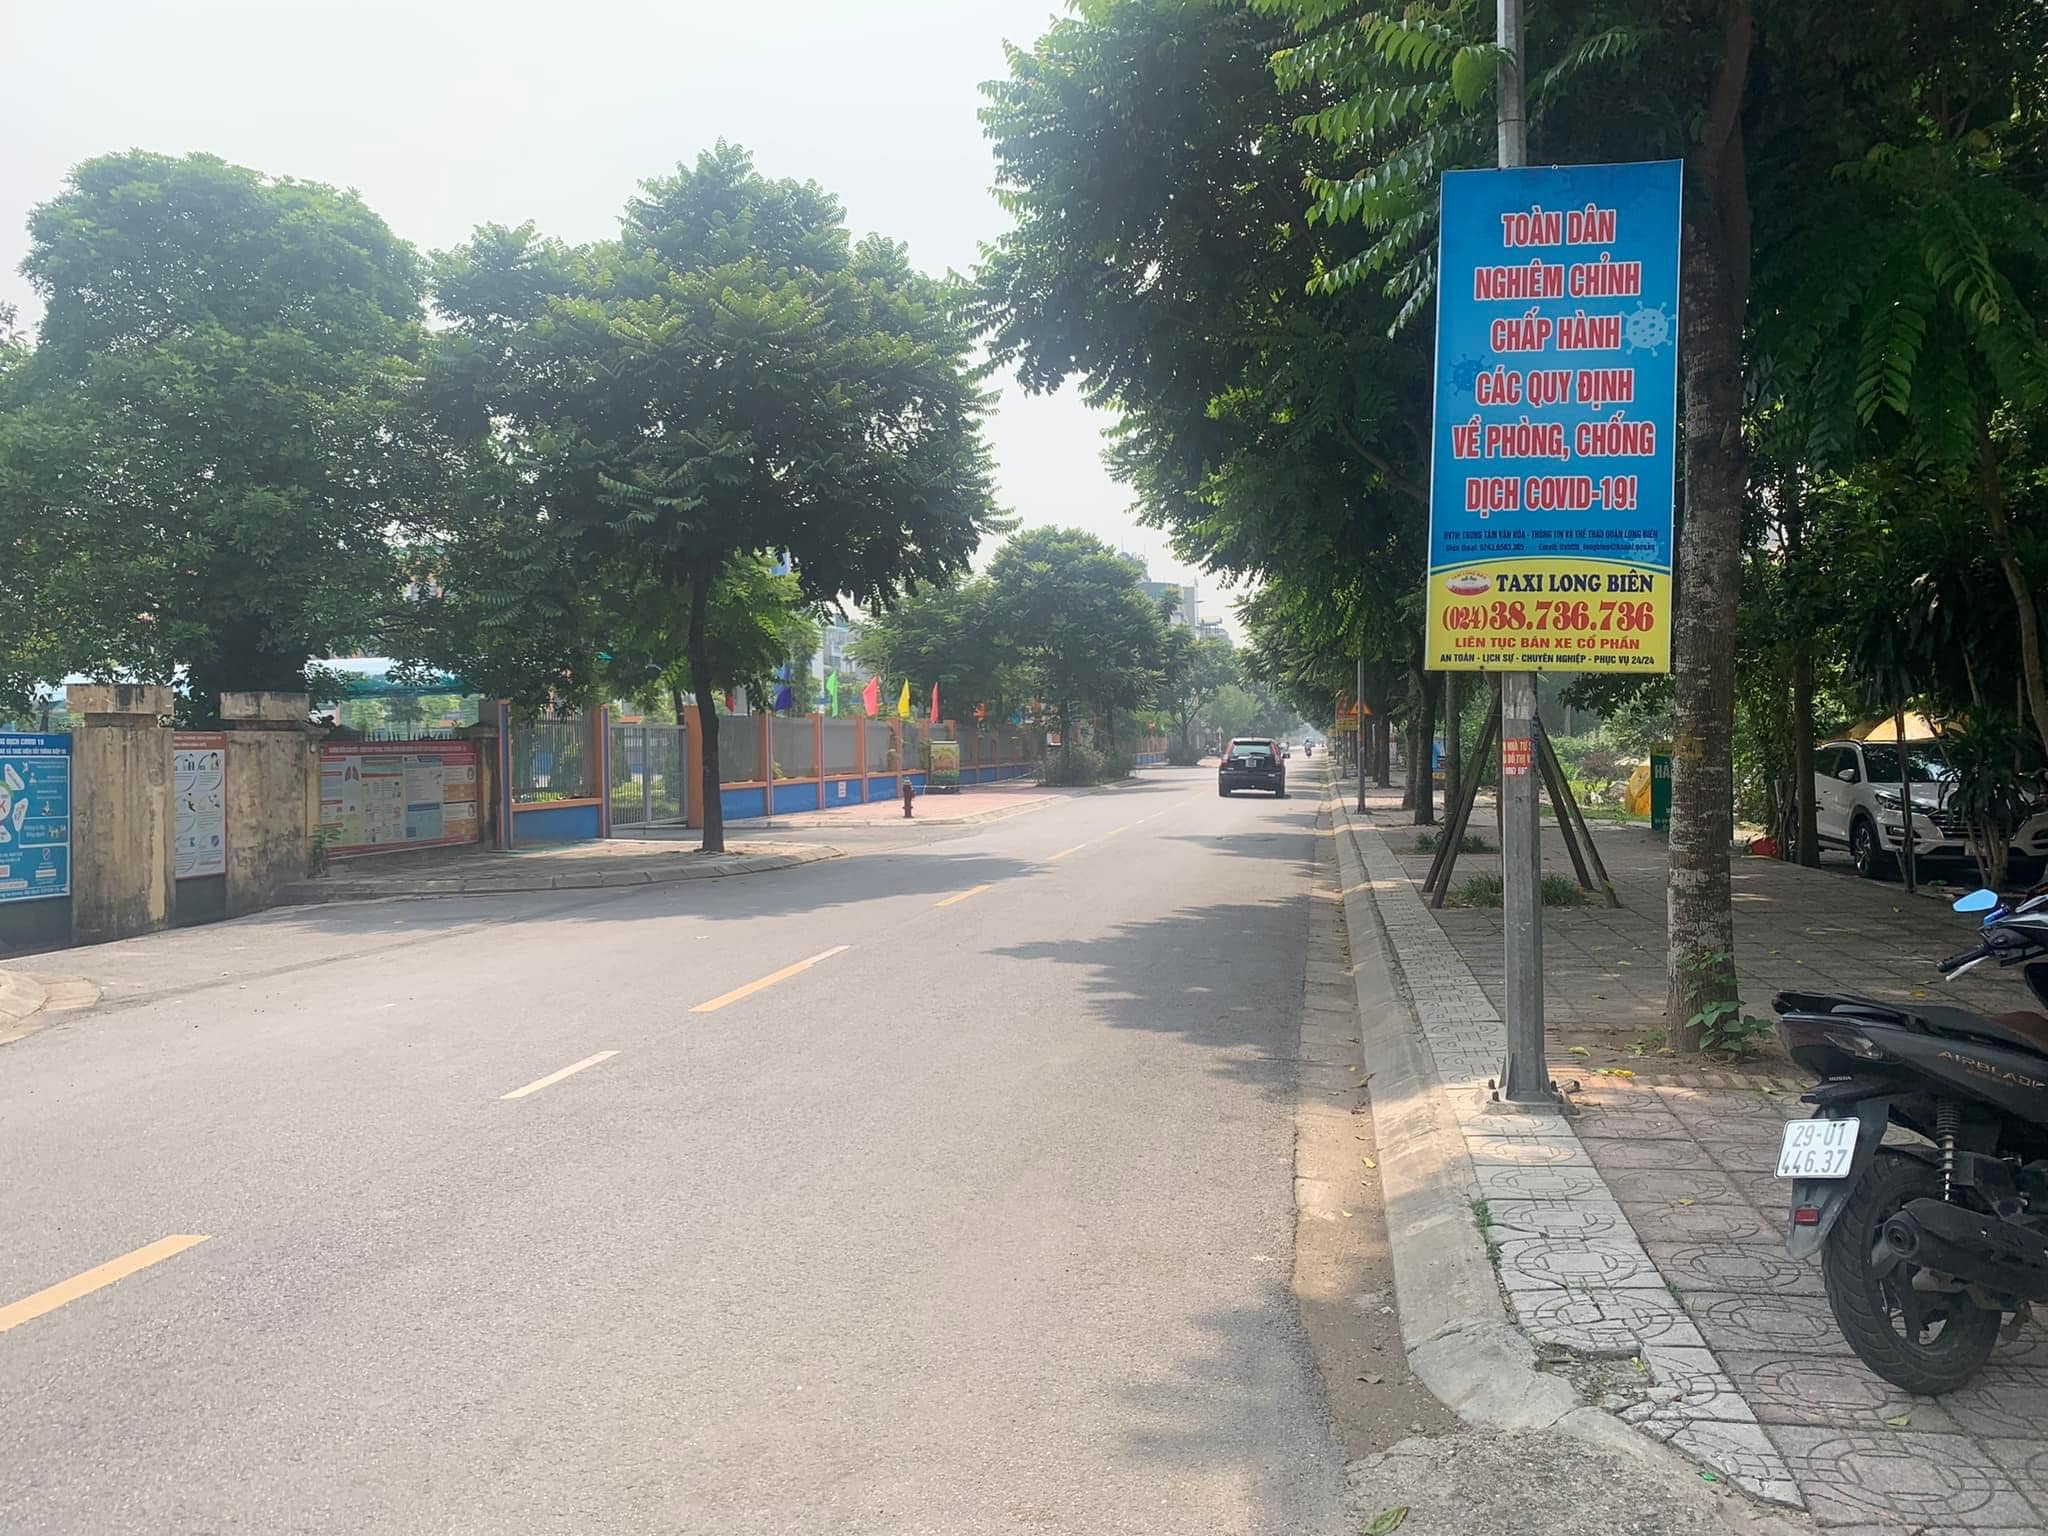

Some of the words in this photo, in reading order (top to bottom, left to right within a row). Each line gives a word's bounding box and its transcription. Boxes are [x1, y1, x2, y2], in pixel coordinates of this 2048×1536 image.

[1501, 206, 1561, 247] TOÀN
[1566, 202, 1615, 244] DÂN
[1474, 258, 1564, 301] NGHIÊM
[1569, 252, 1641, 297] CHỈNH
[1491, 306, 1551, 352] CHẤP
[1557, 310, 1620, 350] HÀNH
[1475, 365, 1522, 405] CÁC
[1527, 369, 1573, 407] QUY
[1577, 368, 1634, 411] ĐỊNH
[1453, 414, 1481, 459] VỀ
[1485, 420, 1570, 461] PHÒNG,
[1575, 411, 1655, 457] CHỐNG
[1466, 477, 1520, 518] DỊCH
[1525, 476, 1637, 512] COVID-19!
[1496, 574, 1545, 592] TAXI
[1549, 574, 1601, 592] LONG
[1607, 569, 1654, 592] BIÊN
[1440, 654, 1452, 662] AN
[1453, 652, 1475, 662] TOÀN
[1482, 653, 1500, 664] LỊCH
[1502, 653, 1514, 664] SỰ
[1521, 653, 1554, 663] CHUYÊN
[1555, 653, 1586, 664] NGHIỆP
[1594, 655, 1617, 666] PHỤC
[1618, 655, 1630, 666] VỤ
[1631, 656, 1655, 665] 24/24
[1455, 635, 1486, 648] LIÊN
[1490, 637, 1516, 650] TỤC
[1554, 638, 1572, 648] XE
[1792, 1123, 1846, 1147] 29-U1
[1781, 1149, 1848, 1174] 446.37
